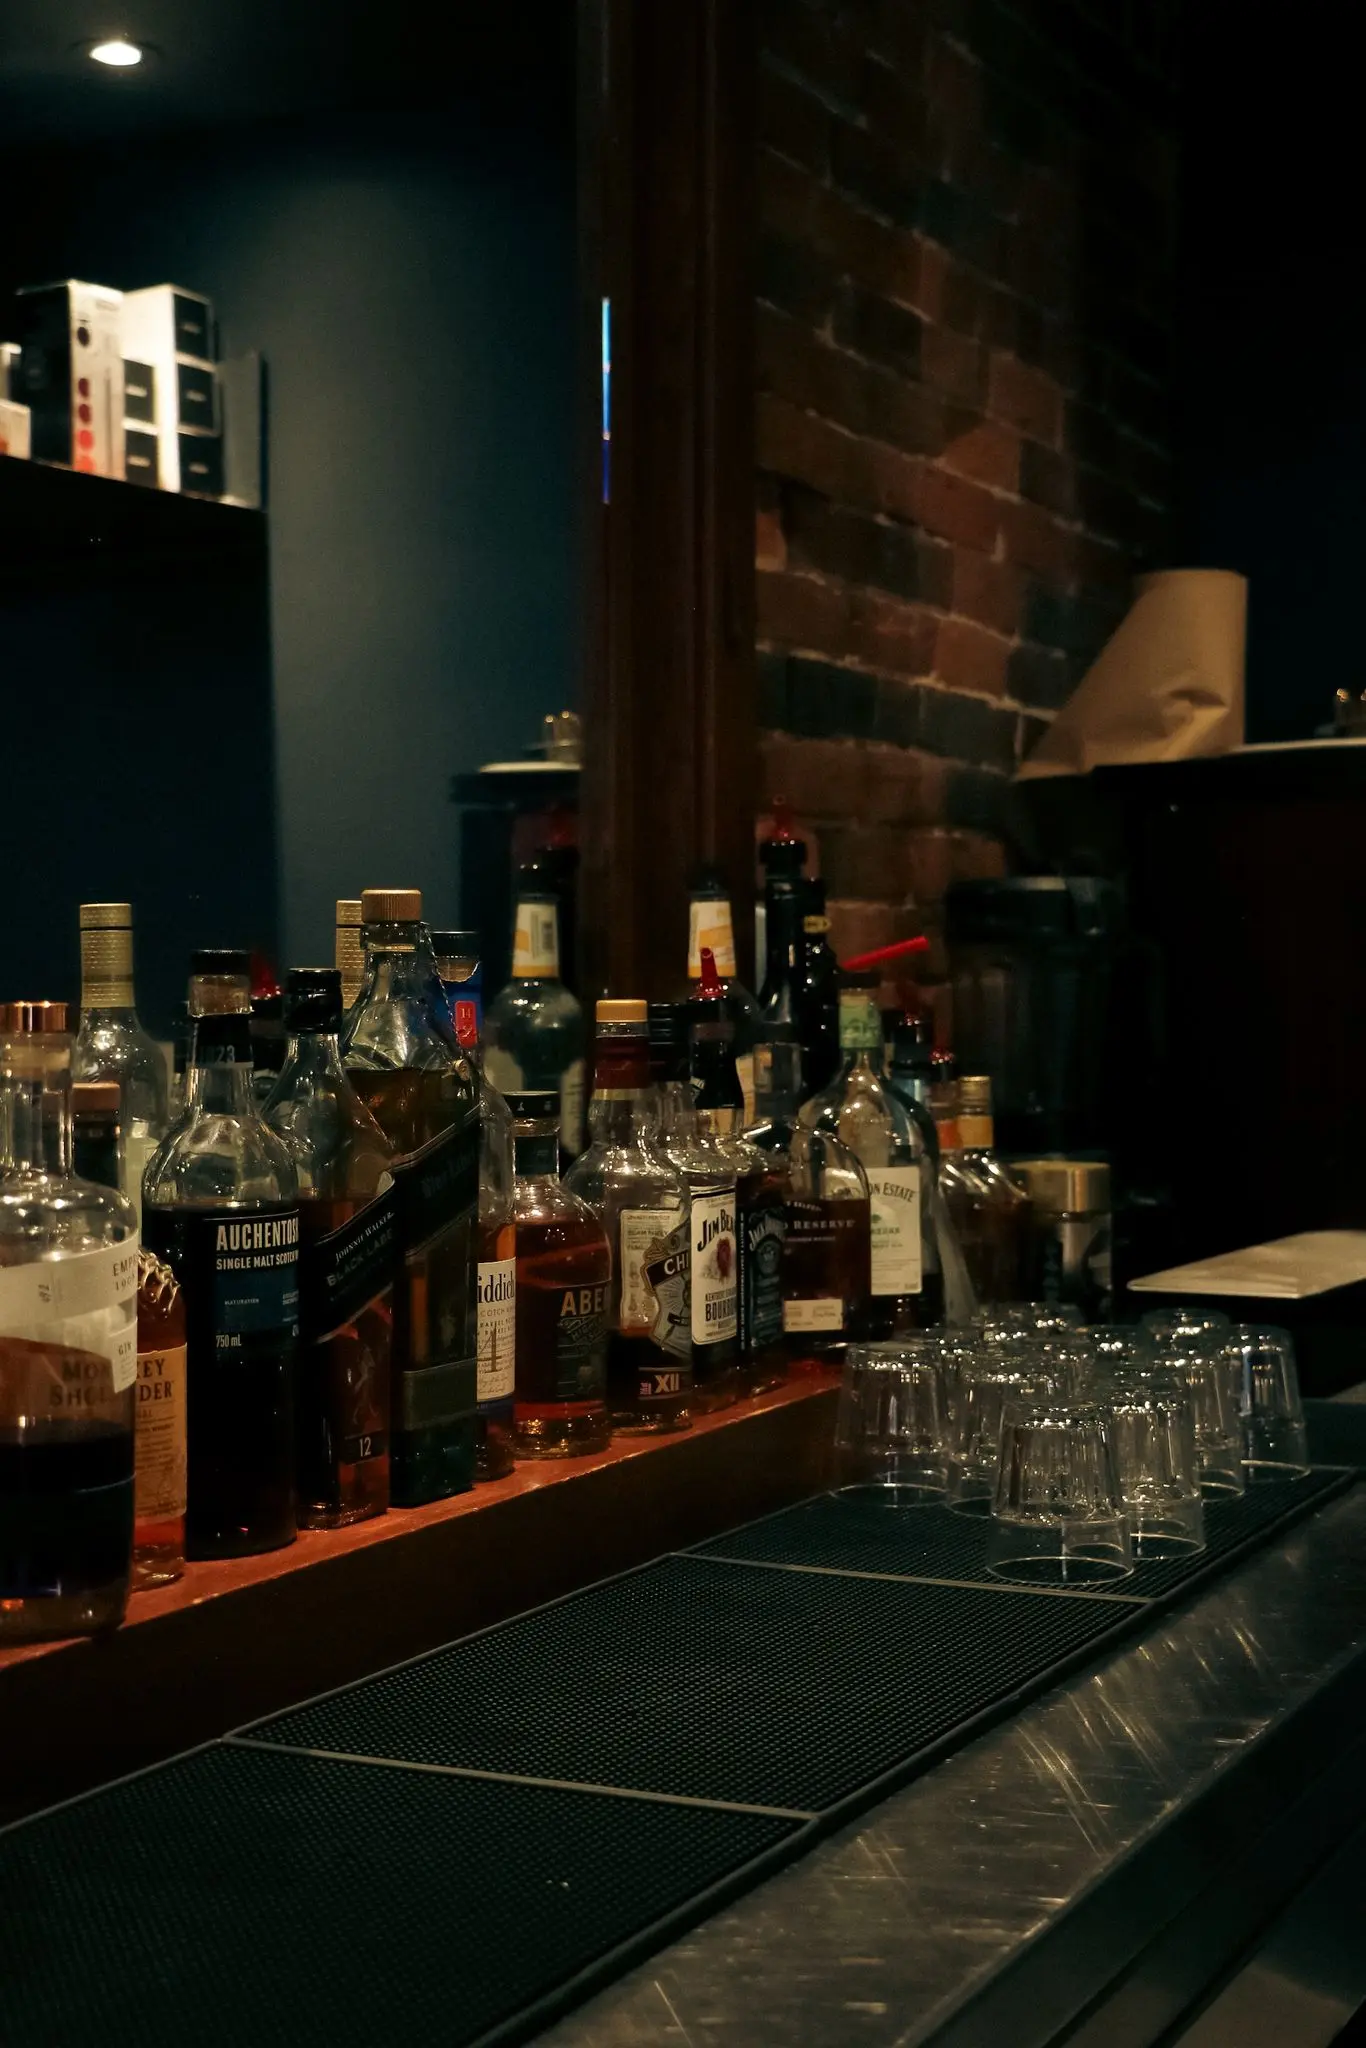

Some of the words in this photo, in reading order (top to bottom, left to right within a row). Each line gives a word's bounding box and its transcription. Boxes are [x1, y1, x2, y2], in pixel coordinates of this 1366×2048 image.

[883, 1182, 915, 1203] ESTATE
[697, 1216, 719, 1252] JIM
[720, 1208, 735, 1236] BEA
[793, 1219, 857, 1231] RESERVE
[367, 1227, 395, 1257] LABE
[216, 1257, 252, 1271] SINGLE
[253, 1254, 275, 1268] MALT
[480, 1307, 505, 1319] COTCH
[118, 1342, 132, 1355] GIN
[215, 1334, 230, 1348] 750
[653, 1371, 680, 1394] XII
[359, 1436, 372, 1458] 12
